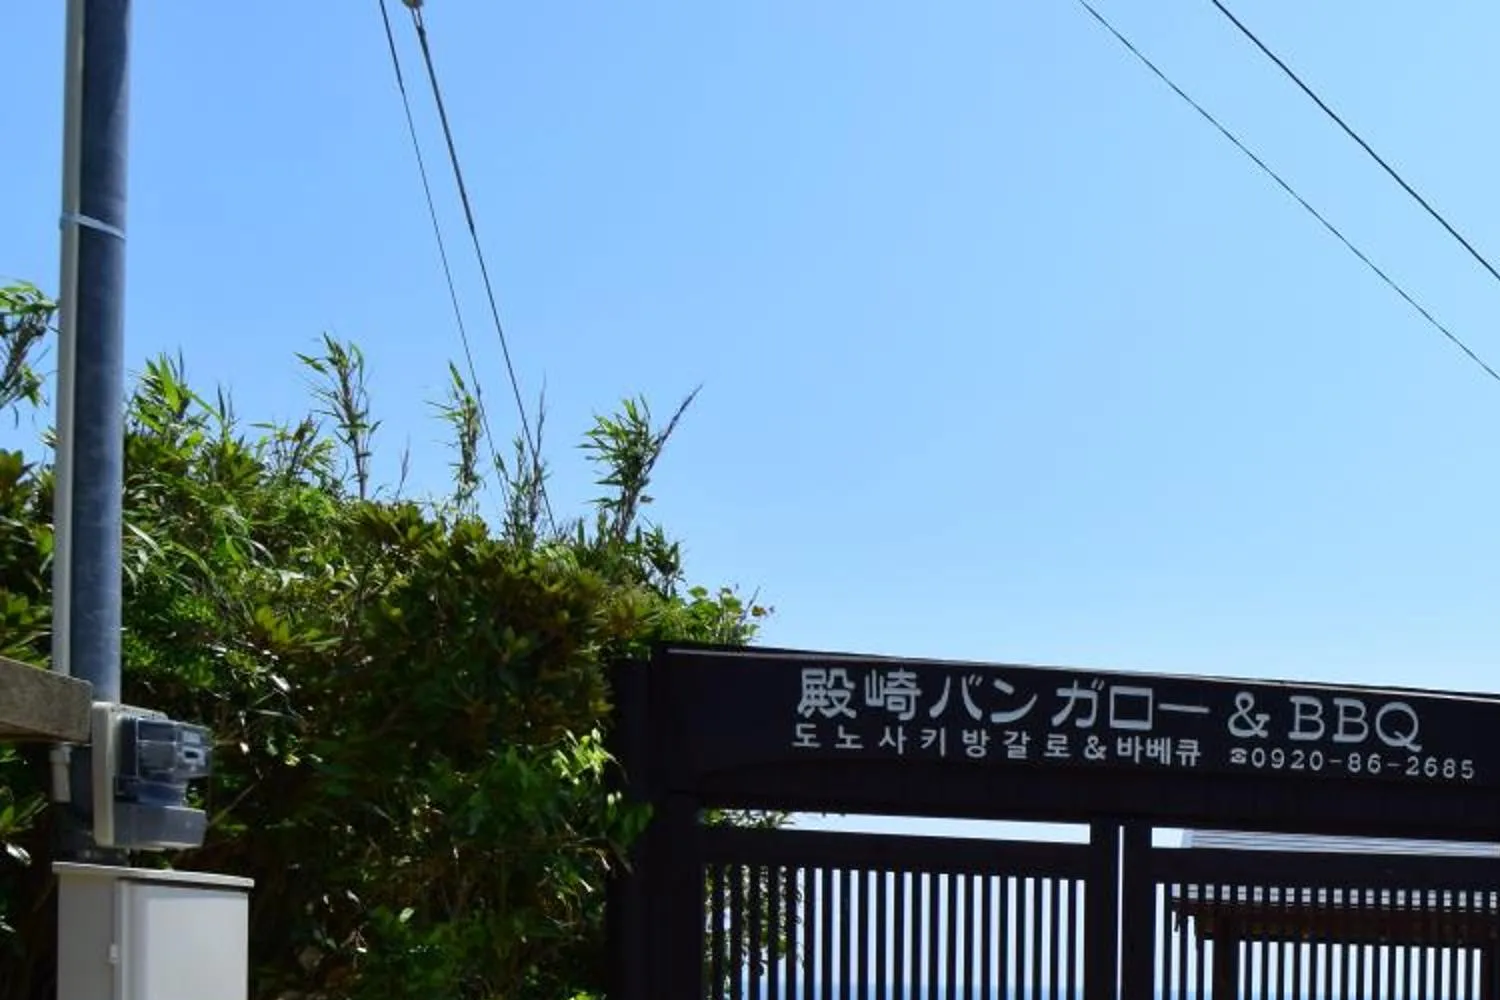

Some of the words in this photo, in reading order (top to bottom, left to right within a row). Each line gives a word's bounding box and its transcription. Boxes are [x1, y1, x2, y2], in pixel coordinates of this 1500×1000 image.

[797, 668, 1210, 731] 殿崎バンガロー
[1227, 691, 1271, 738] &
[1287, 696, 1423, 752] BBQ
[1250, 746, 1476, 780] 0920-86-2685
